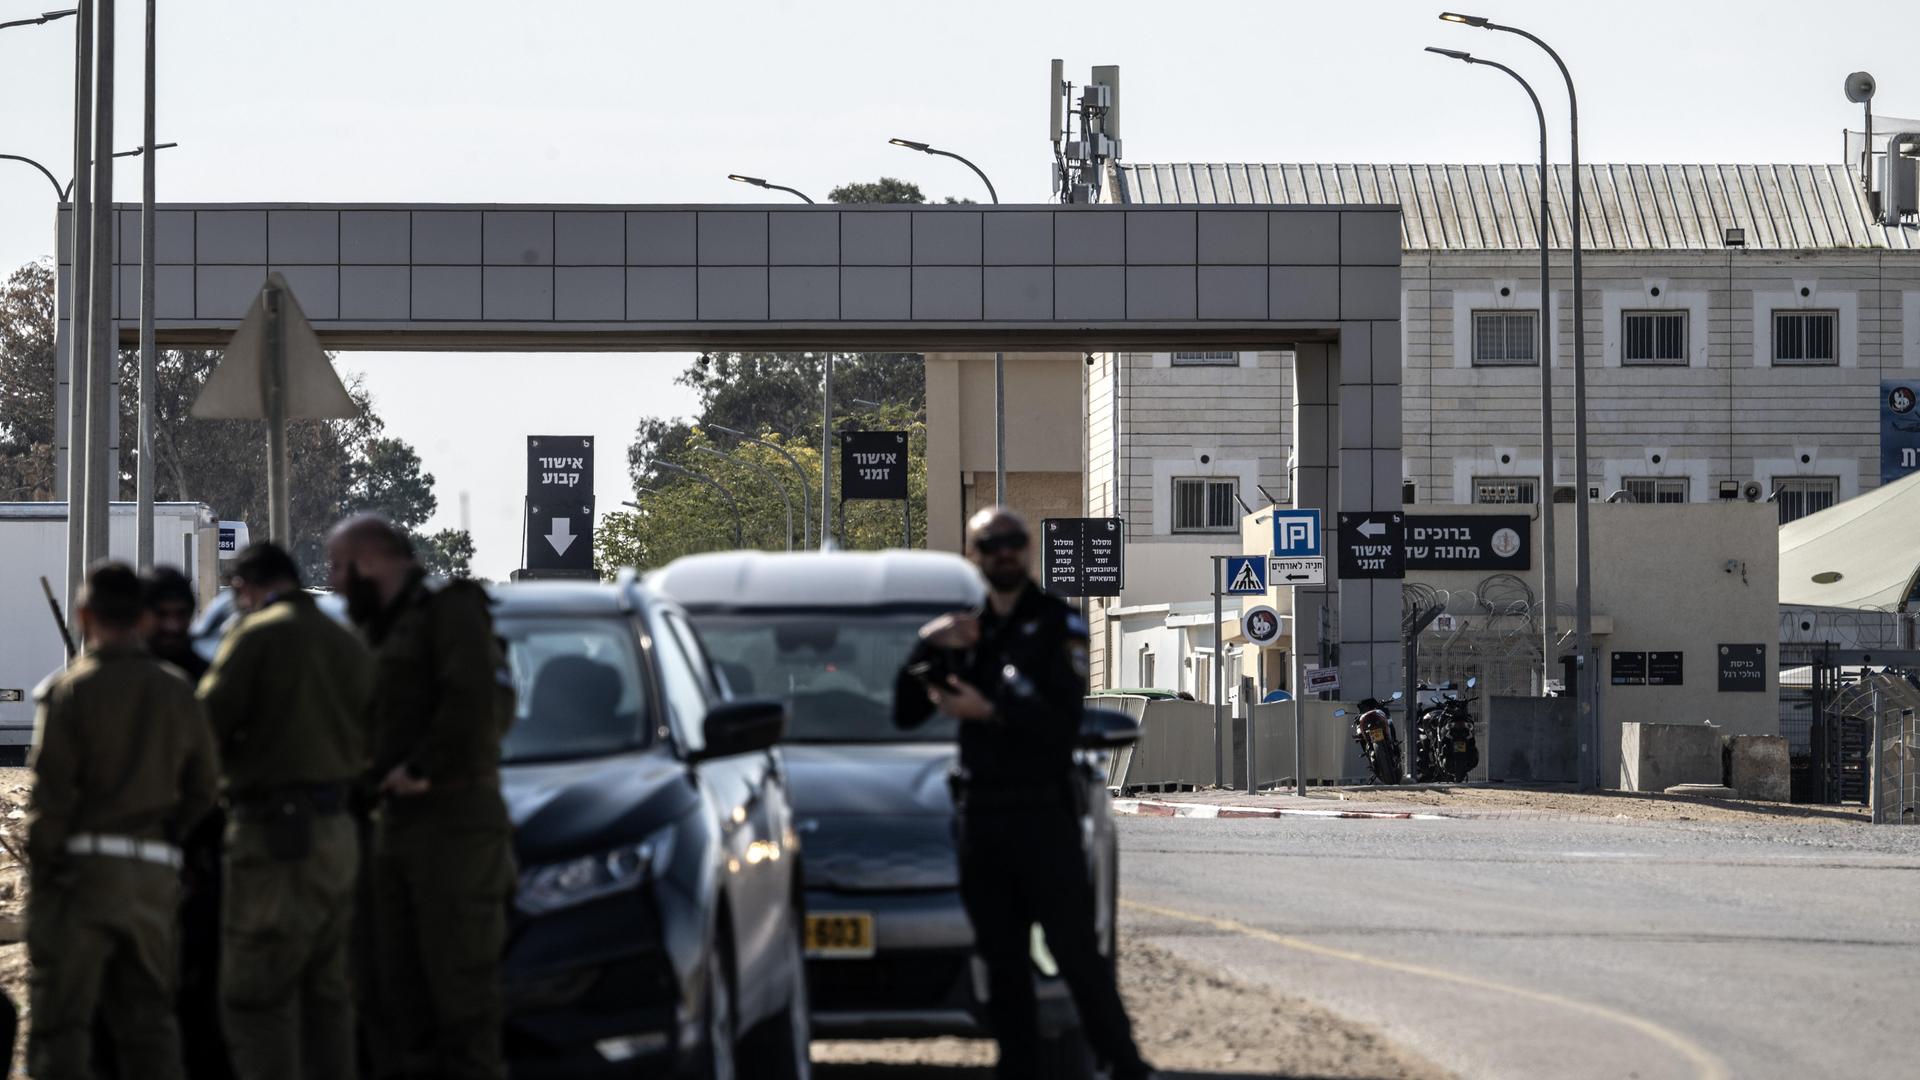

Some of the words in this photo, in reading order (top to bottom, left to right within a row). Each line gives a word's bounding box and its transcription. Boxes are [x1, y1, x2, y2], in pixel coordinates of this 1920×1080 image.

[539, 457, 583, 469] אישור
[853, 453, 897, 465] אישור
[542, 472, 579, 487] קבוע
[859, 468, 890, 480] זמני
[1414, 527, 1471, 540] ברוכים
[1091, 538, 1112, 546] מסלול
[1351, 545, 1392, 556] אישור
[1404, 546, 1429, 558] שד
[1435, 546, 1480, 558] מחנה
[1272, 561, 1303, 570] לאורחים
[1357, 559, 1386, 569] זמני
[1723, 670, 1737, 678] רגל
[1739, 670, 1761, 678] הולכי
